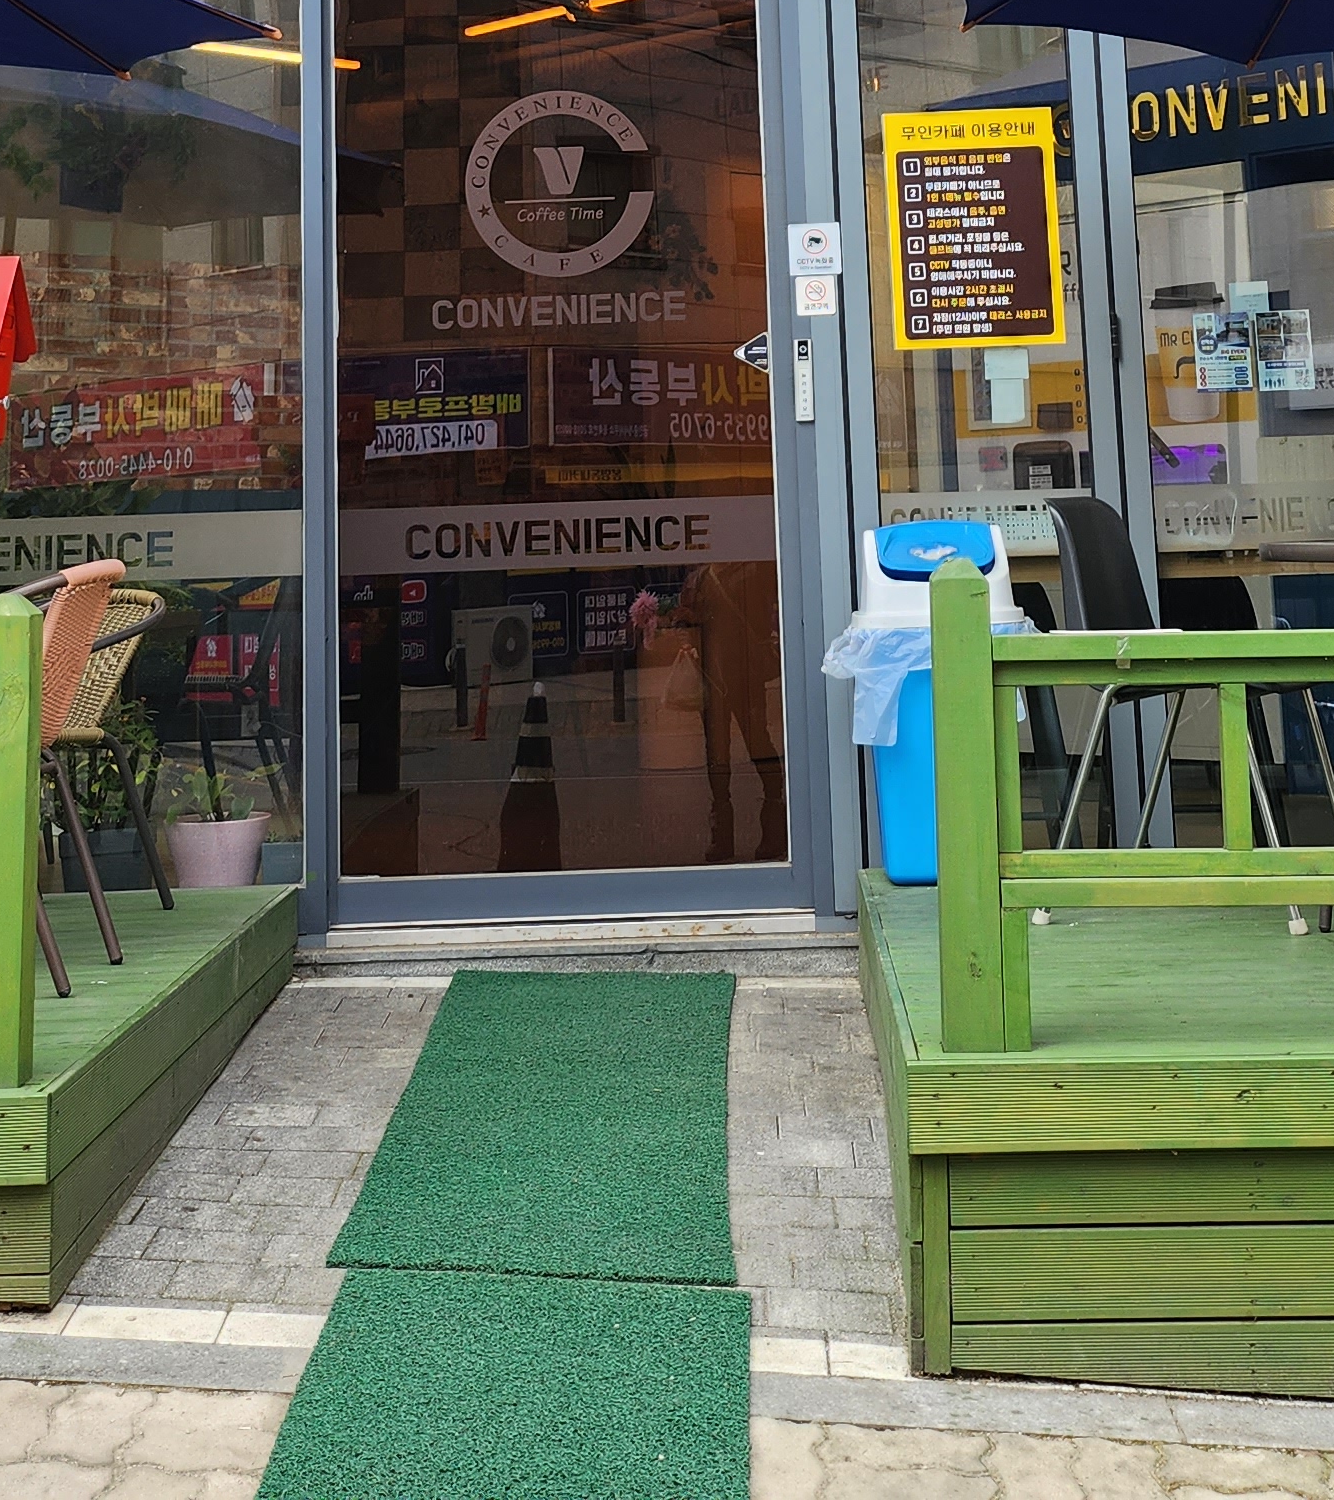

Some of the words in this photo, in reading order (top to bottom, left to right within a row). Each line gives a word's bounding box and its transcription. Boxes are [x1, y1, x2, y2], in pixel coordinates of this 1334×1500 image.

[471, 94, 635, 190] CONVENIENCE
[901, 124, 965, 140] 무인카페
[971, 122, 1035, 138] 이용안내
[517, 206, 566, 223] Coffee
[570, 205, 604, 221] Time
[494, 232, 603, 272] CAFE
[929, 260, 950, 270] CCTV
[931, 285, 964, 297] 이용시간
[965, 284, 988, 295] 2시간
[431, 290, 687, 330] CONVENIENCE
[405, 514, 712, 561] CONVENIENCE
